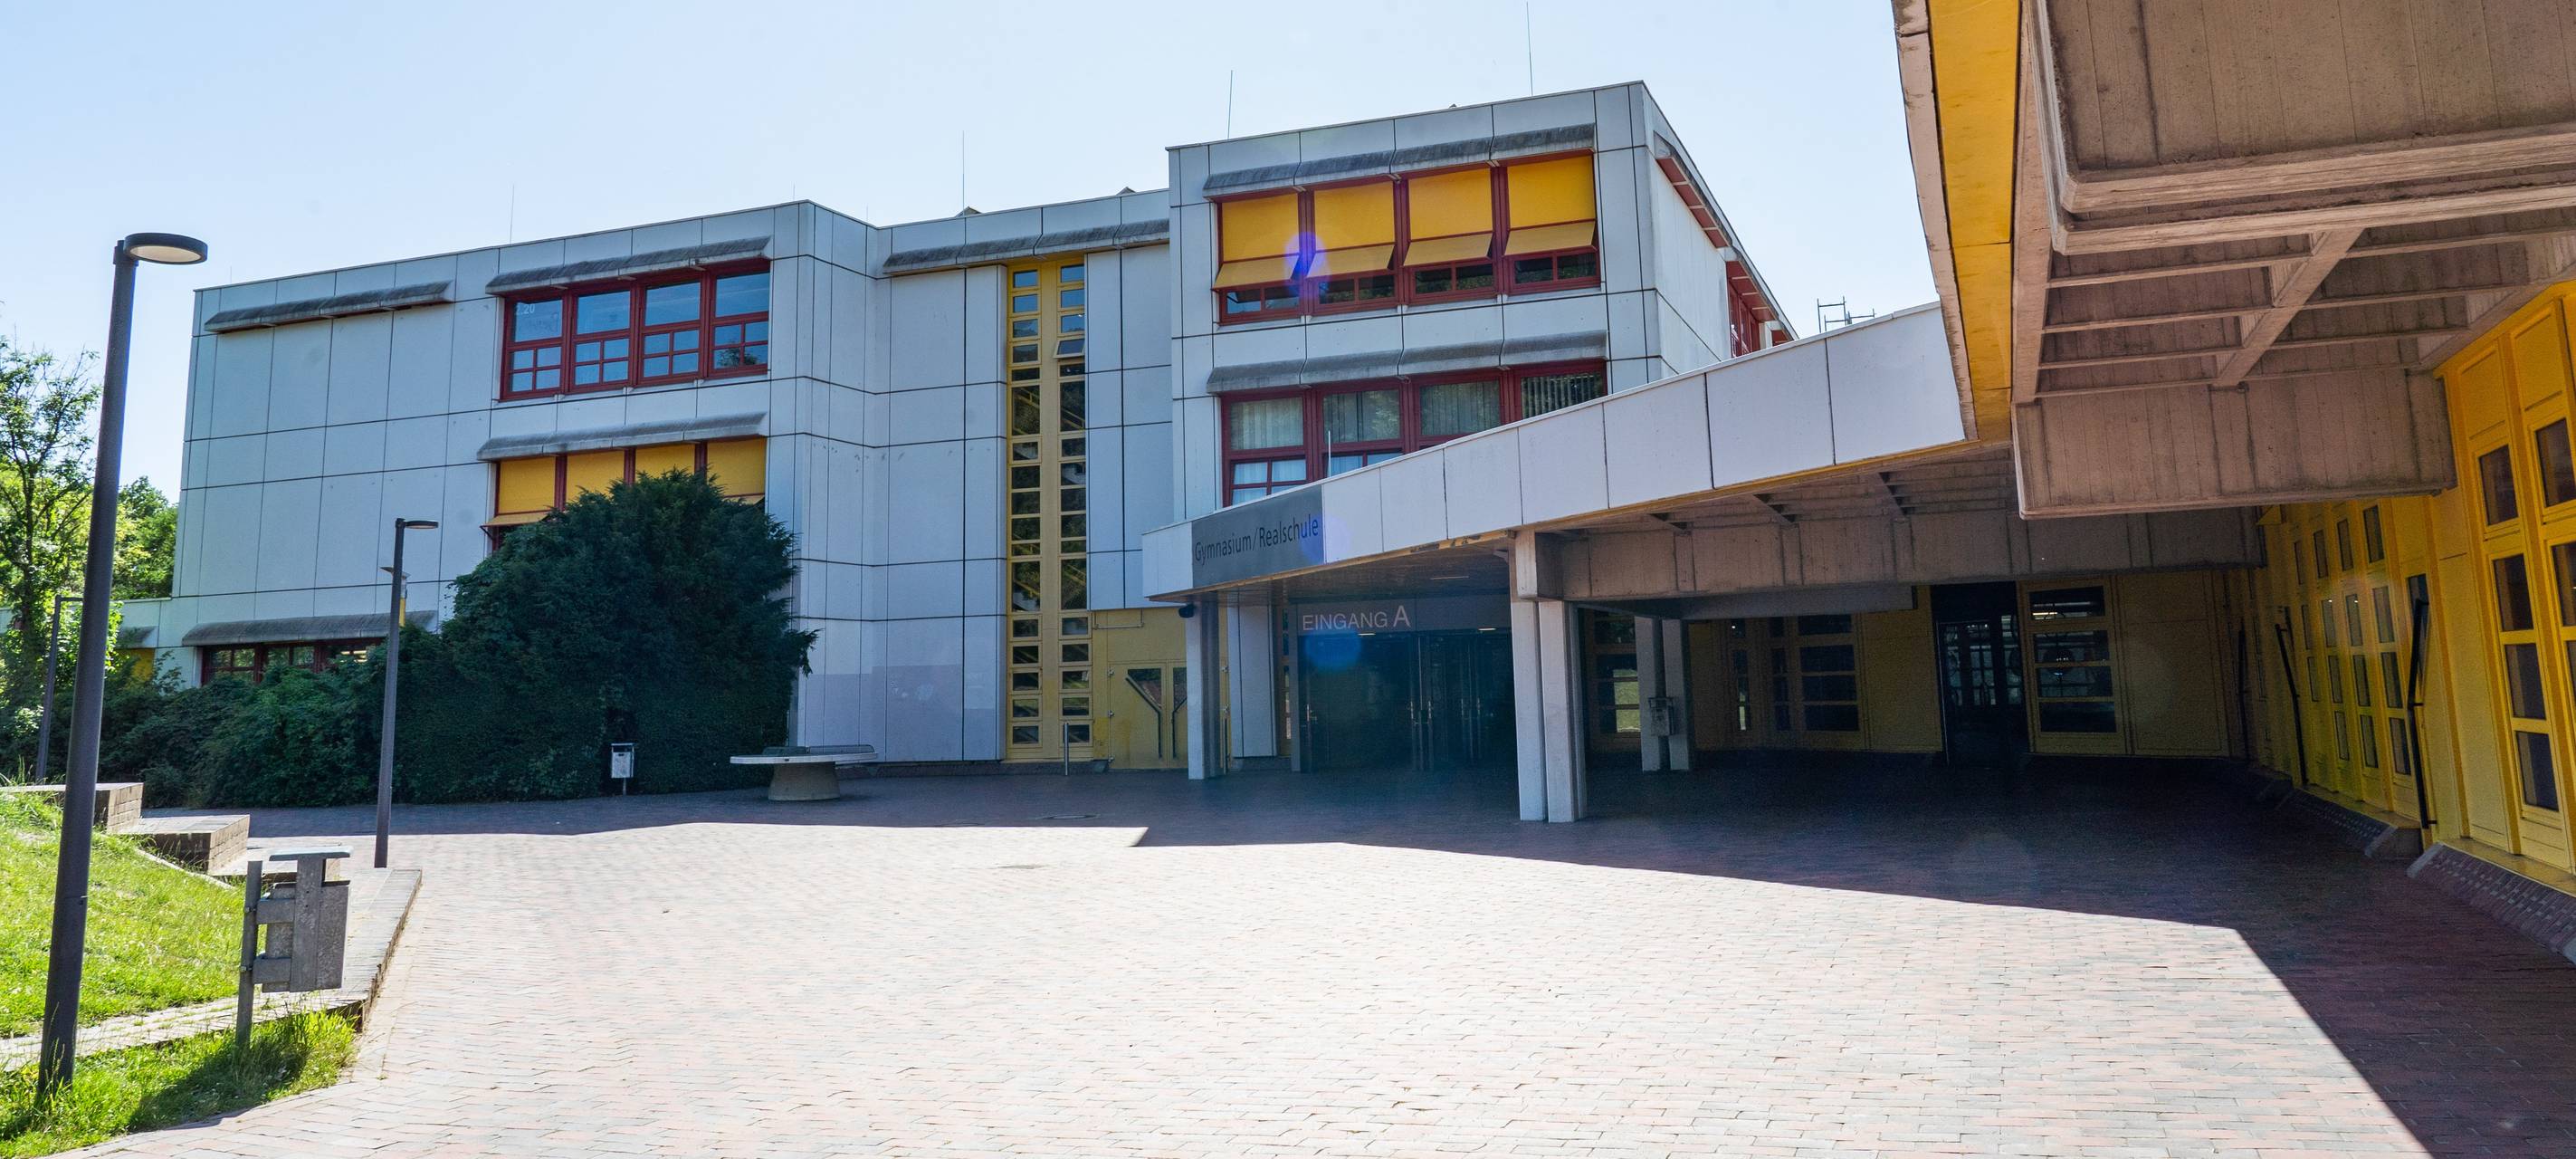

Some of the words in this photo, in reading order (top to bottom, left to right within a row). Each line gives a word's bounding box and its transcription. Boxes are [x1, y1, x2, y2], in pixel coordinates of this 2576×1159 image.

[1195, 514, 1319, 565] Gymnasium/Realschule
[1303, 611, 1388, 630] EINGANG
[1393, 605, 1411, 627] A
